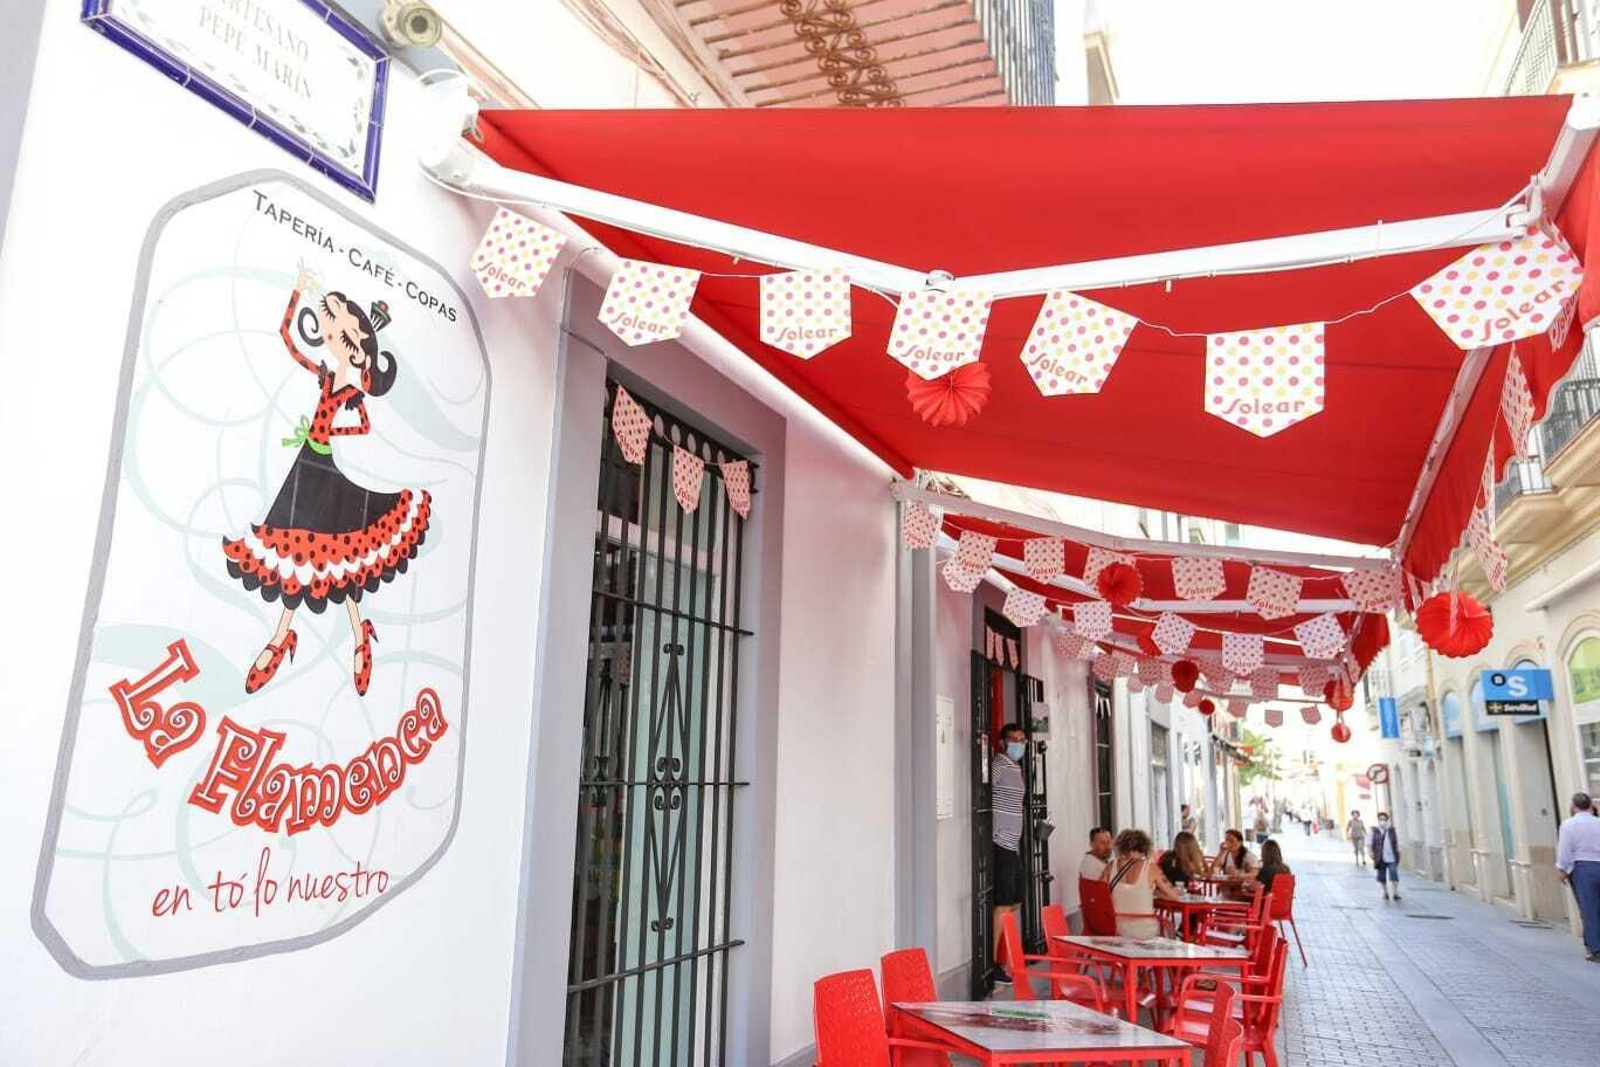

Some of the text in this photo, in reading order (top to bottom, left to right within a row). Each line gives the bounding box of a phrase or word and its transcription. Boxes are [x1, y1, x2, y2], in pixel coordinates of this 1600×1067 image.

[349, 248, 394, 288] CAFÉ
[406, 281, 457, 322] COPAS
[478, 261, 526, 290] Solear
[610, 311, 669, 334] Solear
[1479, 280, 1565, 341] Solear
[774, 327, 838, 342] Solear
[900, 346, 966, 362] Solear
[1028, 352, 1089, 387] Solear
[1222, 398, 1306, 415] Solear
[1507, 675, 1528, 697] S
[109, 638, 448, 836] La Flamenca
[152, 846, 390, 917] en tó lo nuestro
